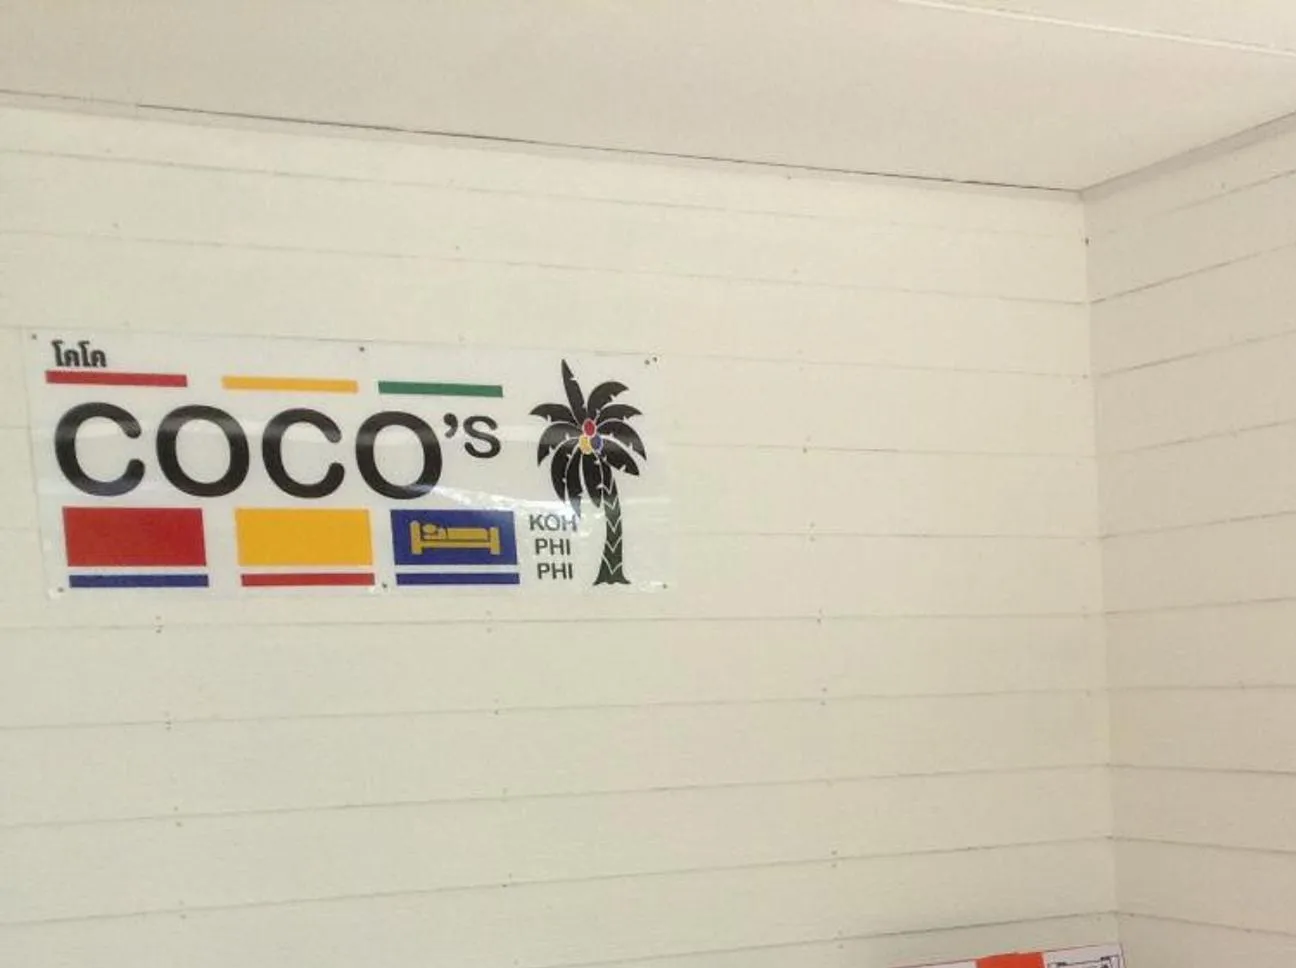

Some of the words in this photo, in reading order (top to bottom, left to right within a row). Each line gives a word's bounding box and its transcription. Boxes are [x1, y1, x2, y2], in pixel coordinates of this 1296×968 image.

[529, 514, 578, 532] KOH
[535, 538, 570, 555] PHI
[537, 562, 573, 580] PHI
